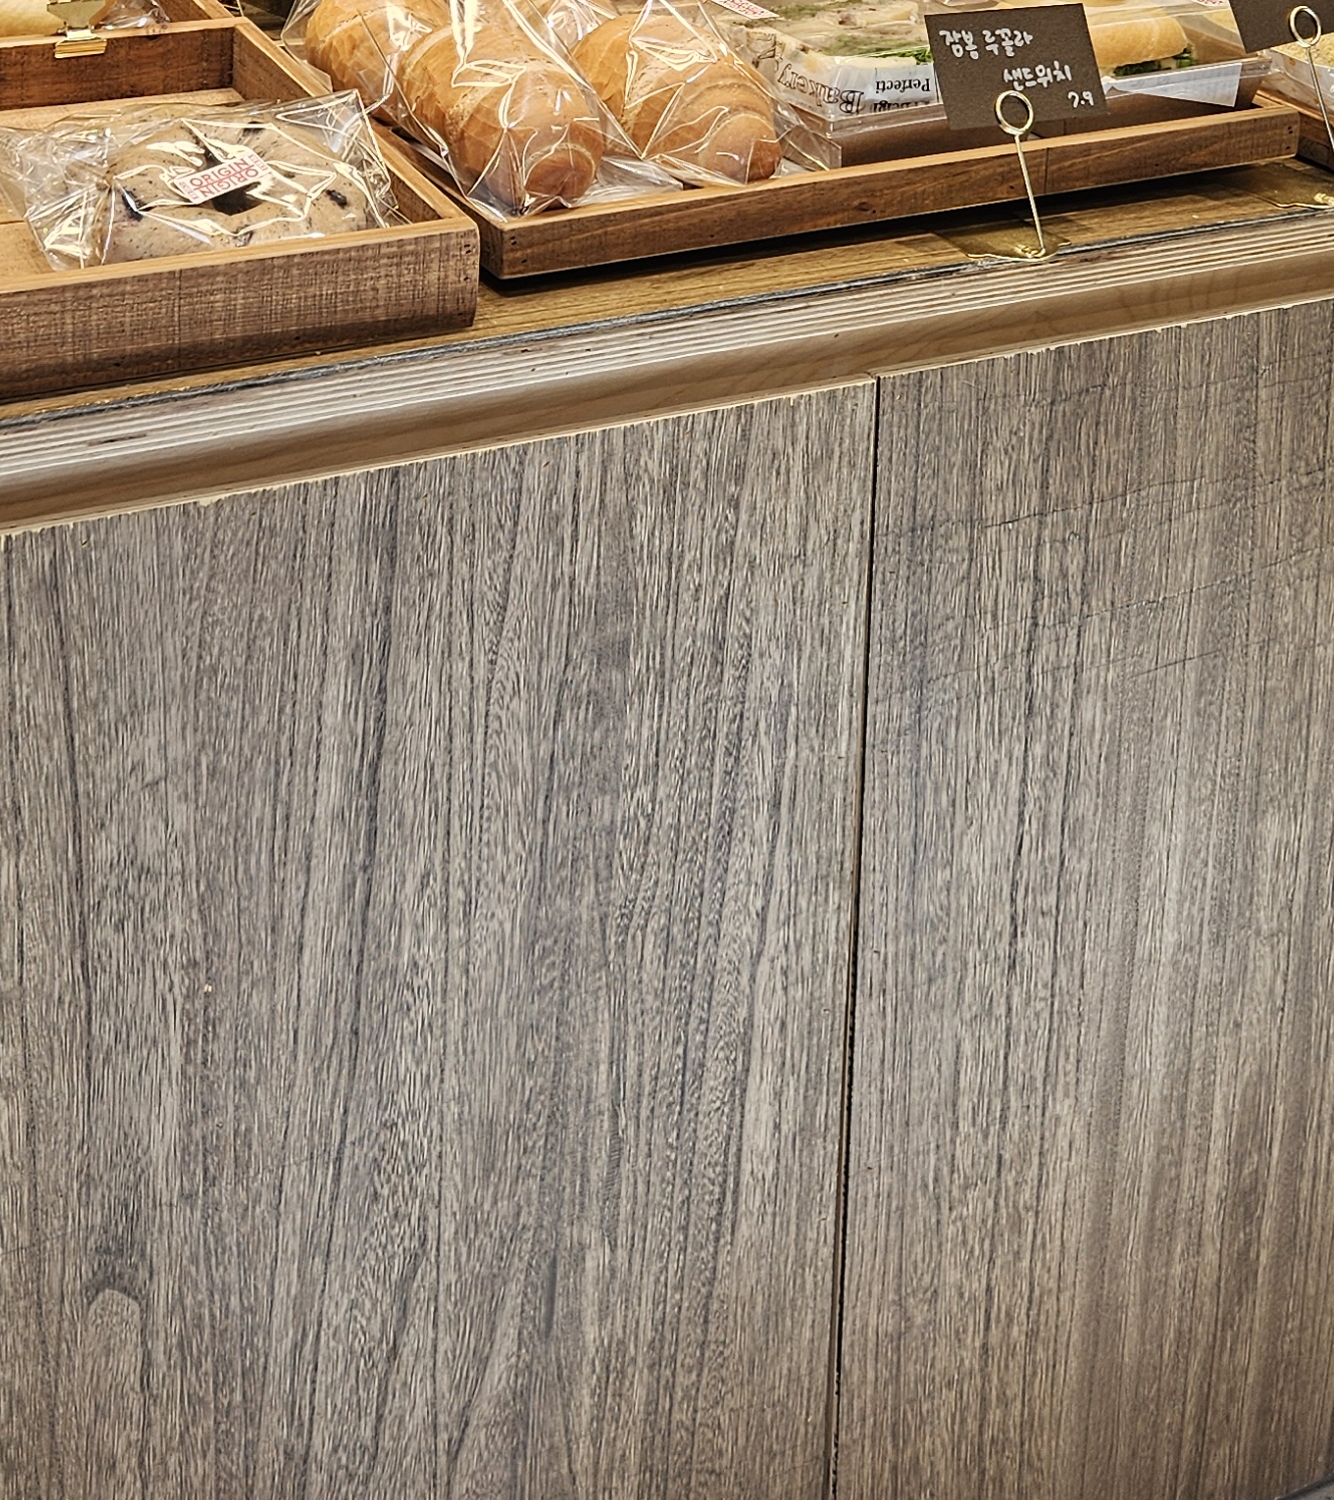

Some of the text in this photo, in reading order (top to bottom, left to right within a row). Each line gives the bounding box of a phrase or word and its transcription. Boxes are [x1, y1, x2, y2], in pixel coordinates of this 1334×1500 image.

[938, 27, 1034, 60] 잠봉 루꼴라
[1002, 60, 1073, 91] 샌드위치
[1067, 90, 1095, 108] 7.9
[190, 158, 250, 187] ORIGIN
[199, 167, 259, 198] ORIGIN
